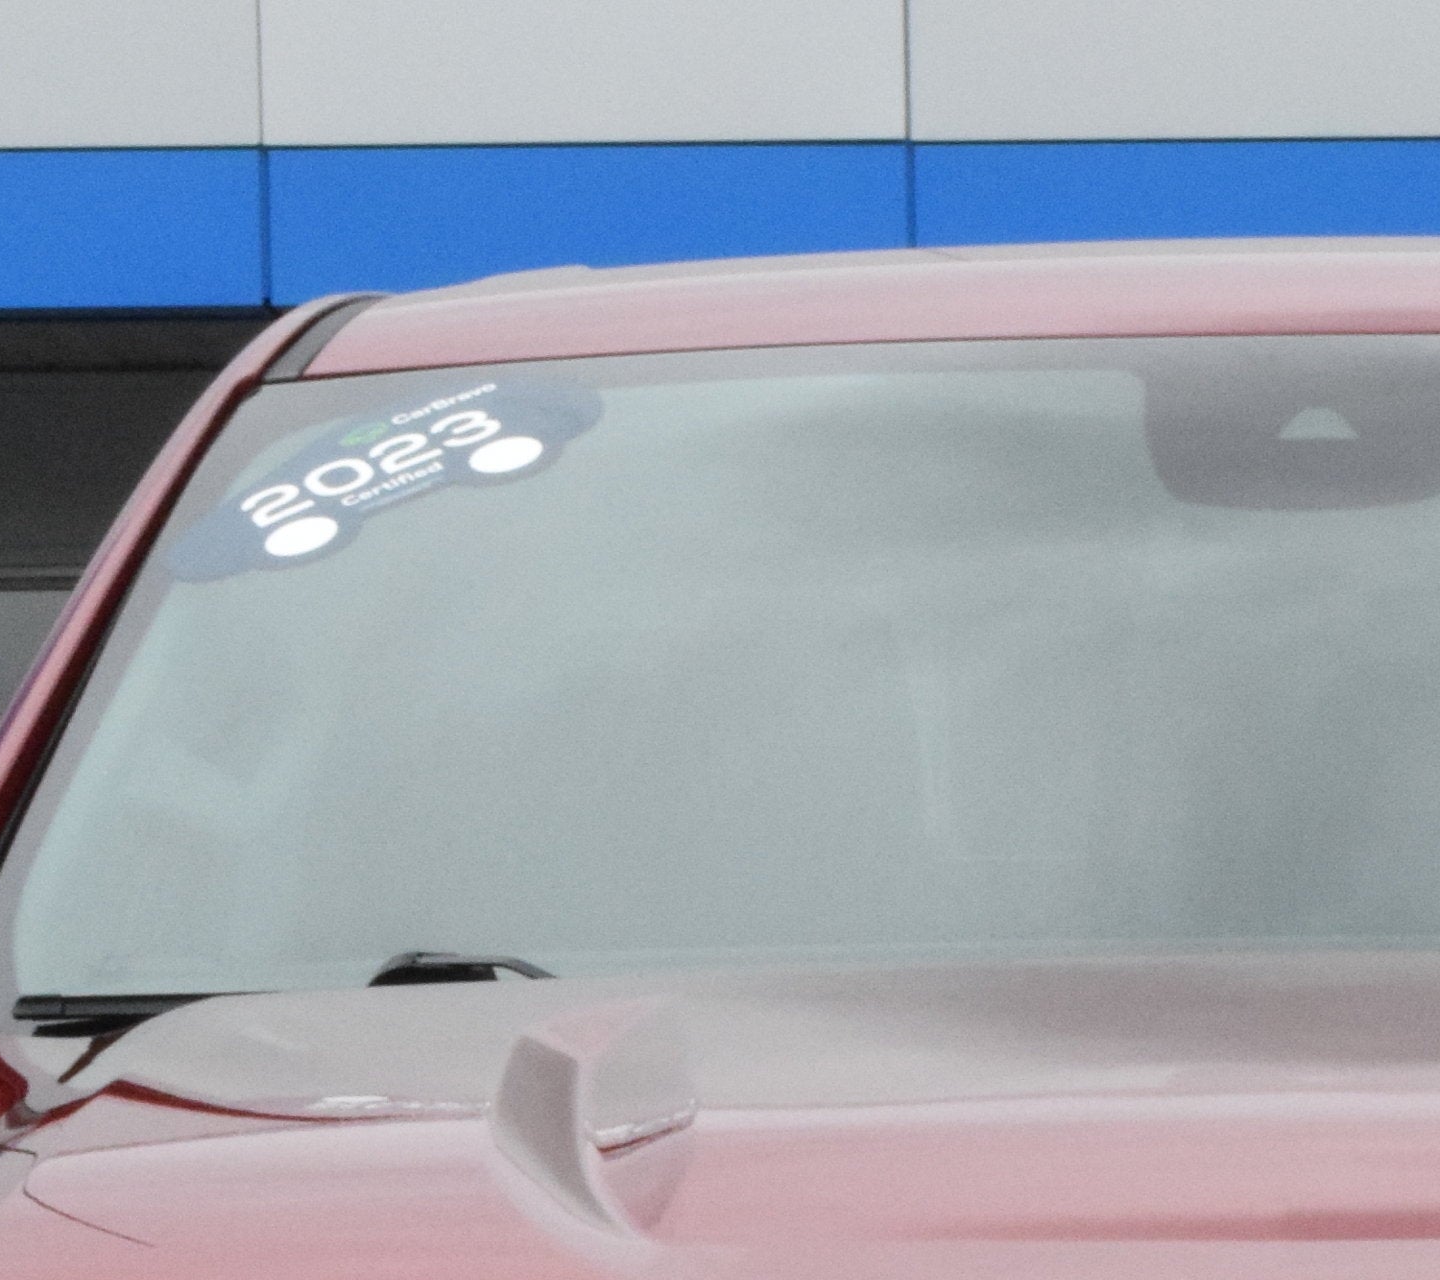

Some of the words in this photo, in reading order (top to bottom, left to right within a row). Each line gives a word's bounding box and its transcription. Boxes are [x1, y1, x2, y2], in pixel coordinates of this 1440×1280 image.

[391, 383, 497, 425] CarBravo
[240, 410, 502, 529] 2023
[341, 461, 444, 507] Certified
